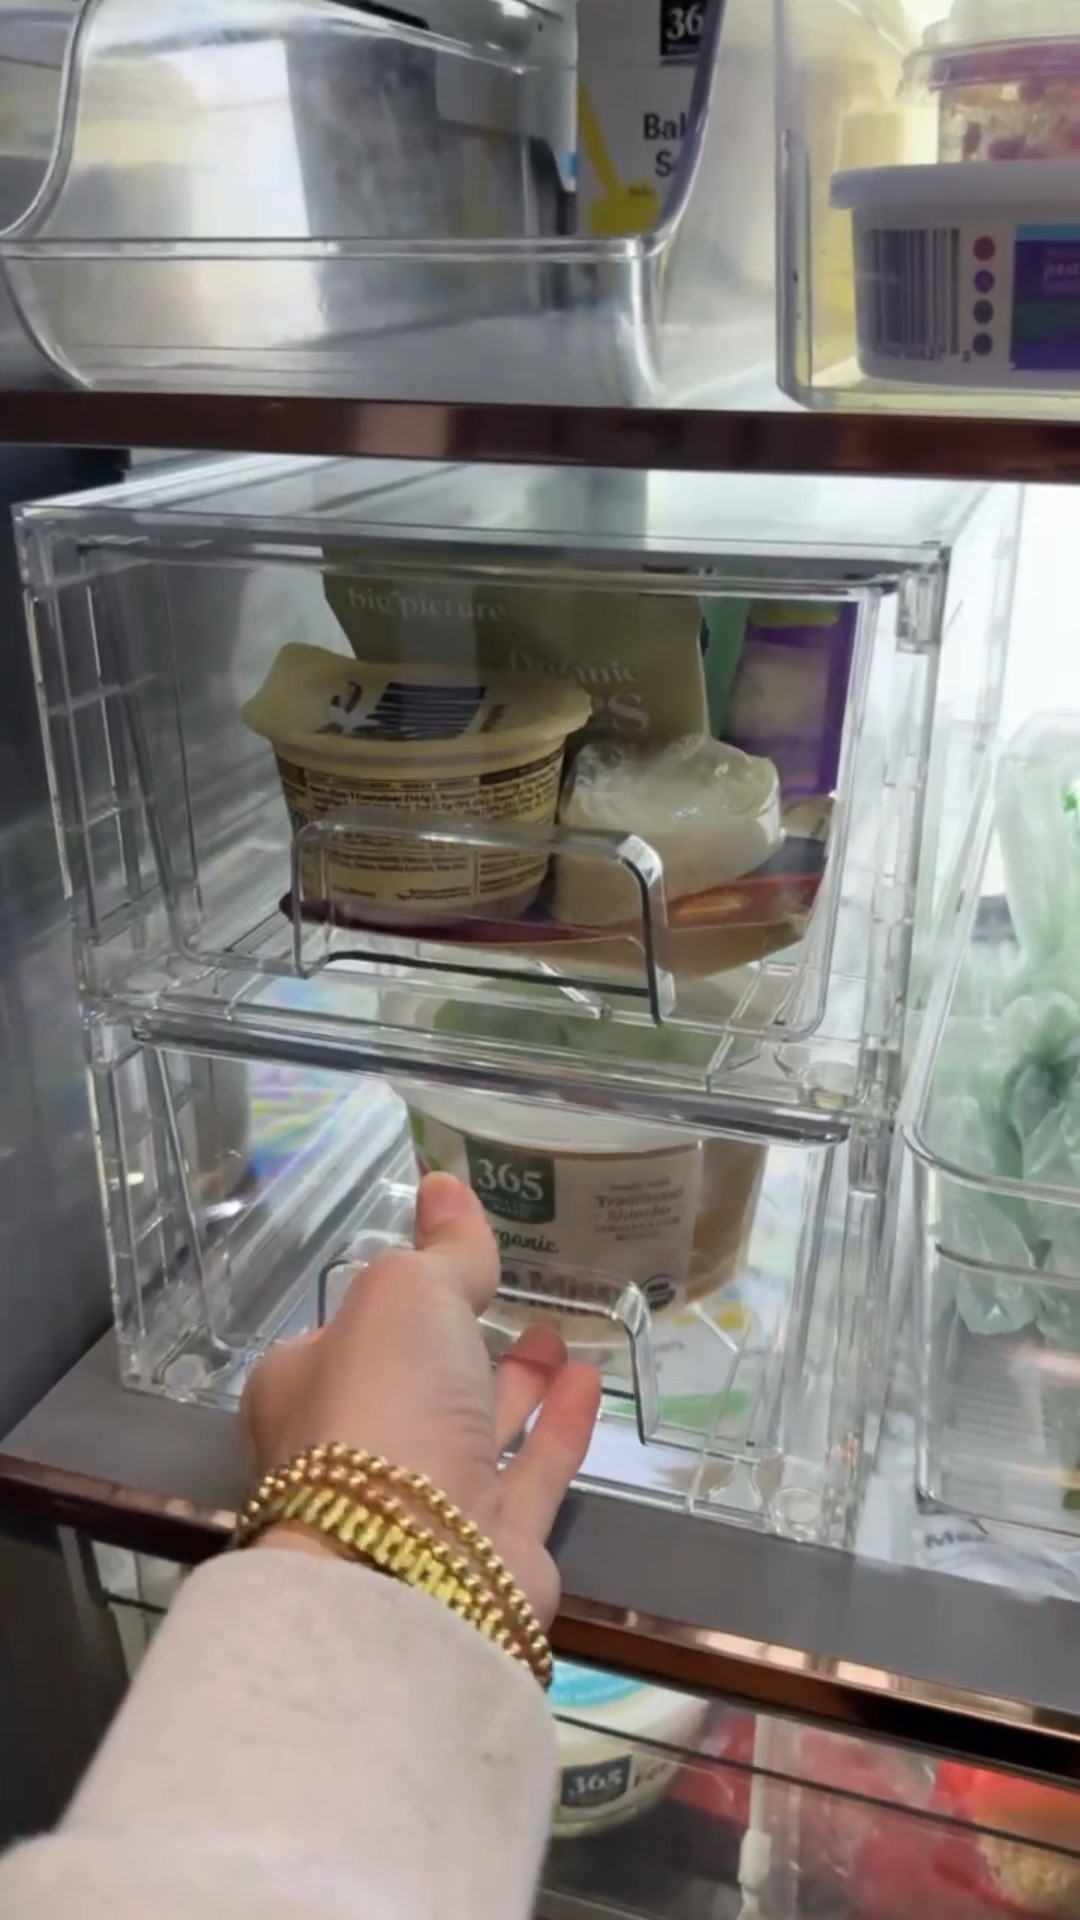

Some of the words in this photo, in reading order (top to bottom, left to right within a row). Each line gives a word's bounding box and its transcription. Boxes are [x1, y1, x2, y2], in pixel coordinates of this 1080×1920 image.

[666, 4, 704, 41] 36
[400, 592, 505, 621] picture
[478, 1158, 544, 1201] 365
[493, 1228, 560, 1255] rganic
[566, 1767, 623, 1799] 365
